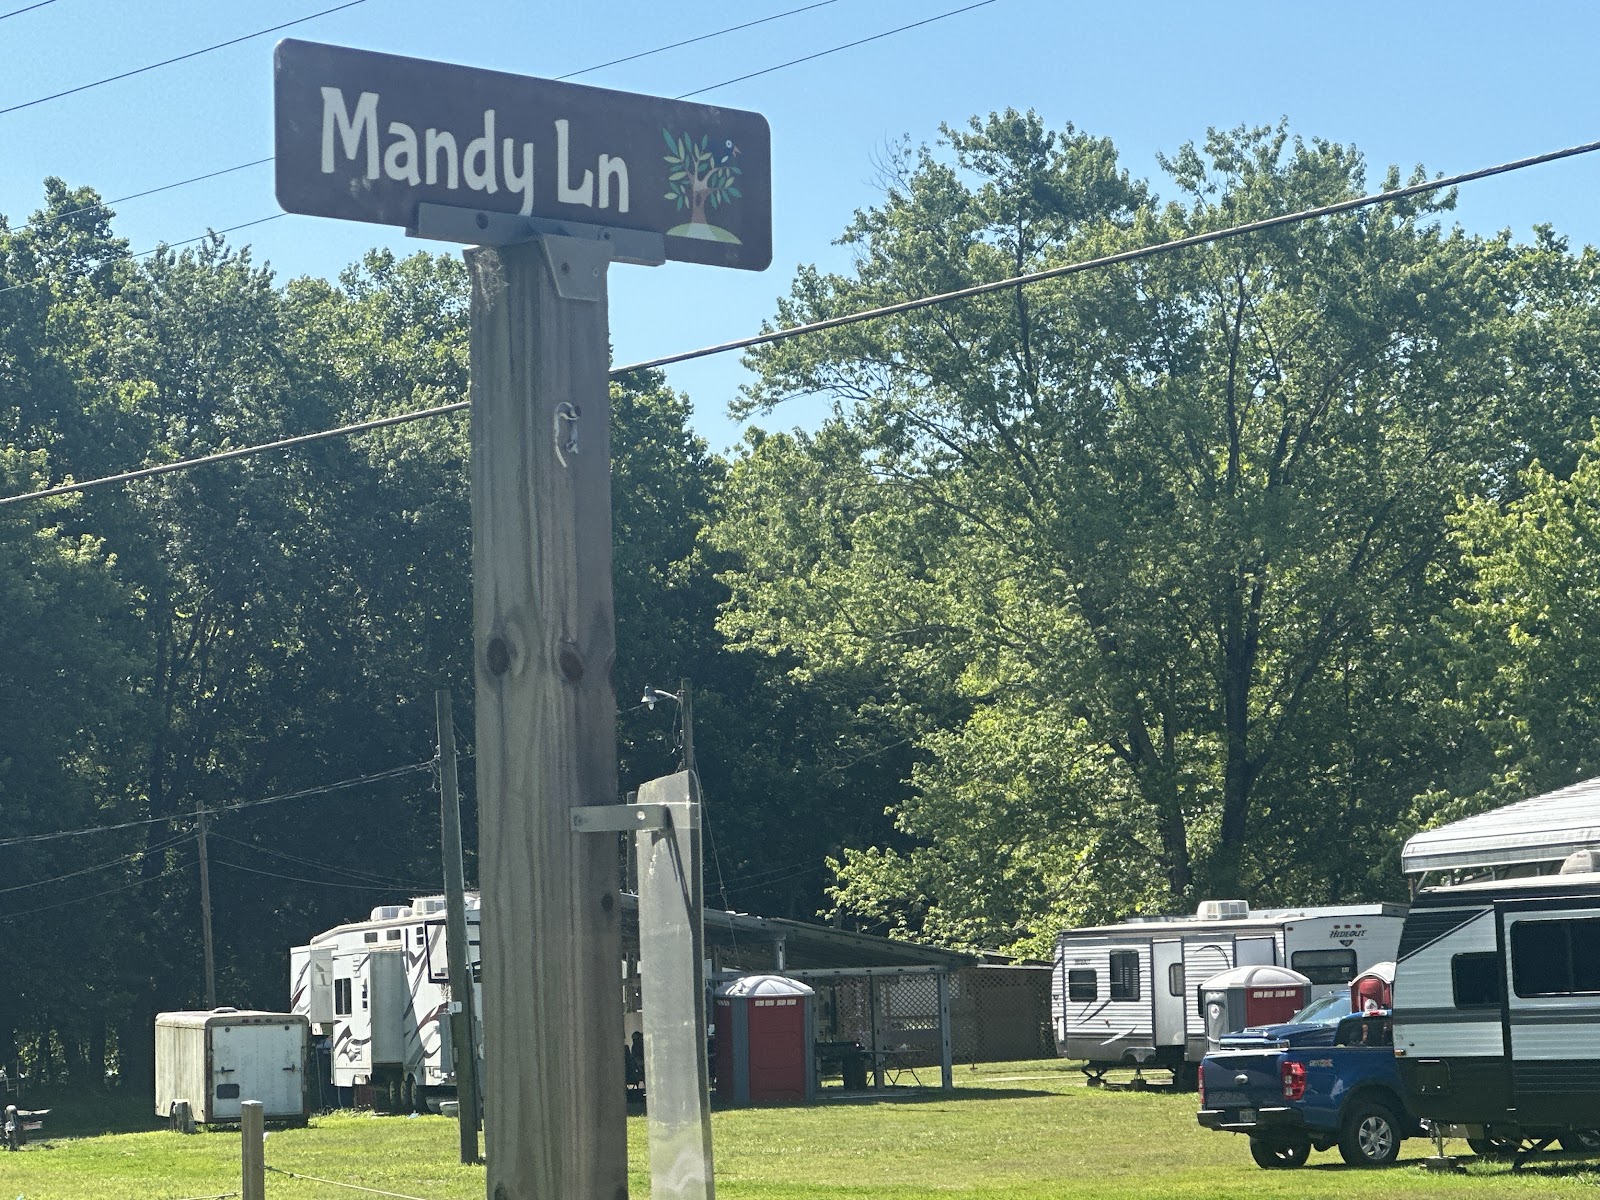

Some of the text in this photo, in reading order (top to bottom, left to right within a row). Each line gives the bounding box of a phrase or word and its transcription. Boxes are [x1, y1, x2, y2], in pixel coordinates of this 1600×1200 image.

[320, 86, 629, 217] Mandy Ln
[1329, 929, 1368, 938] HIDEOUT
